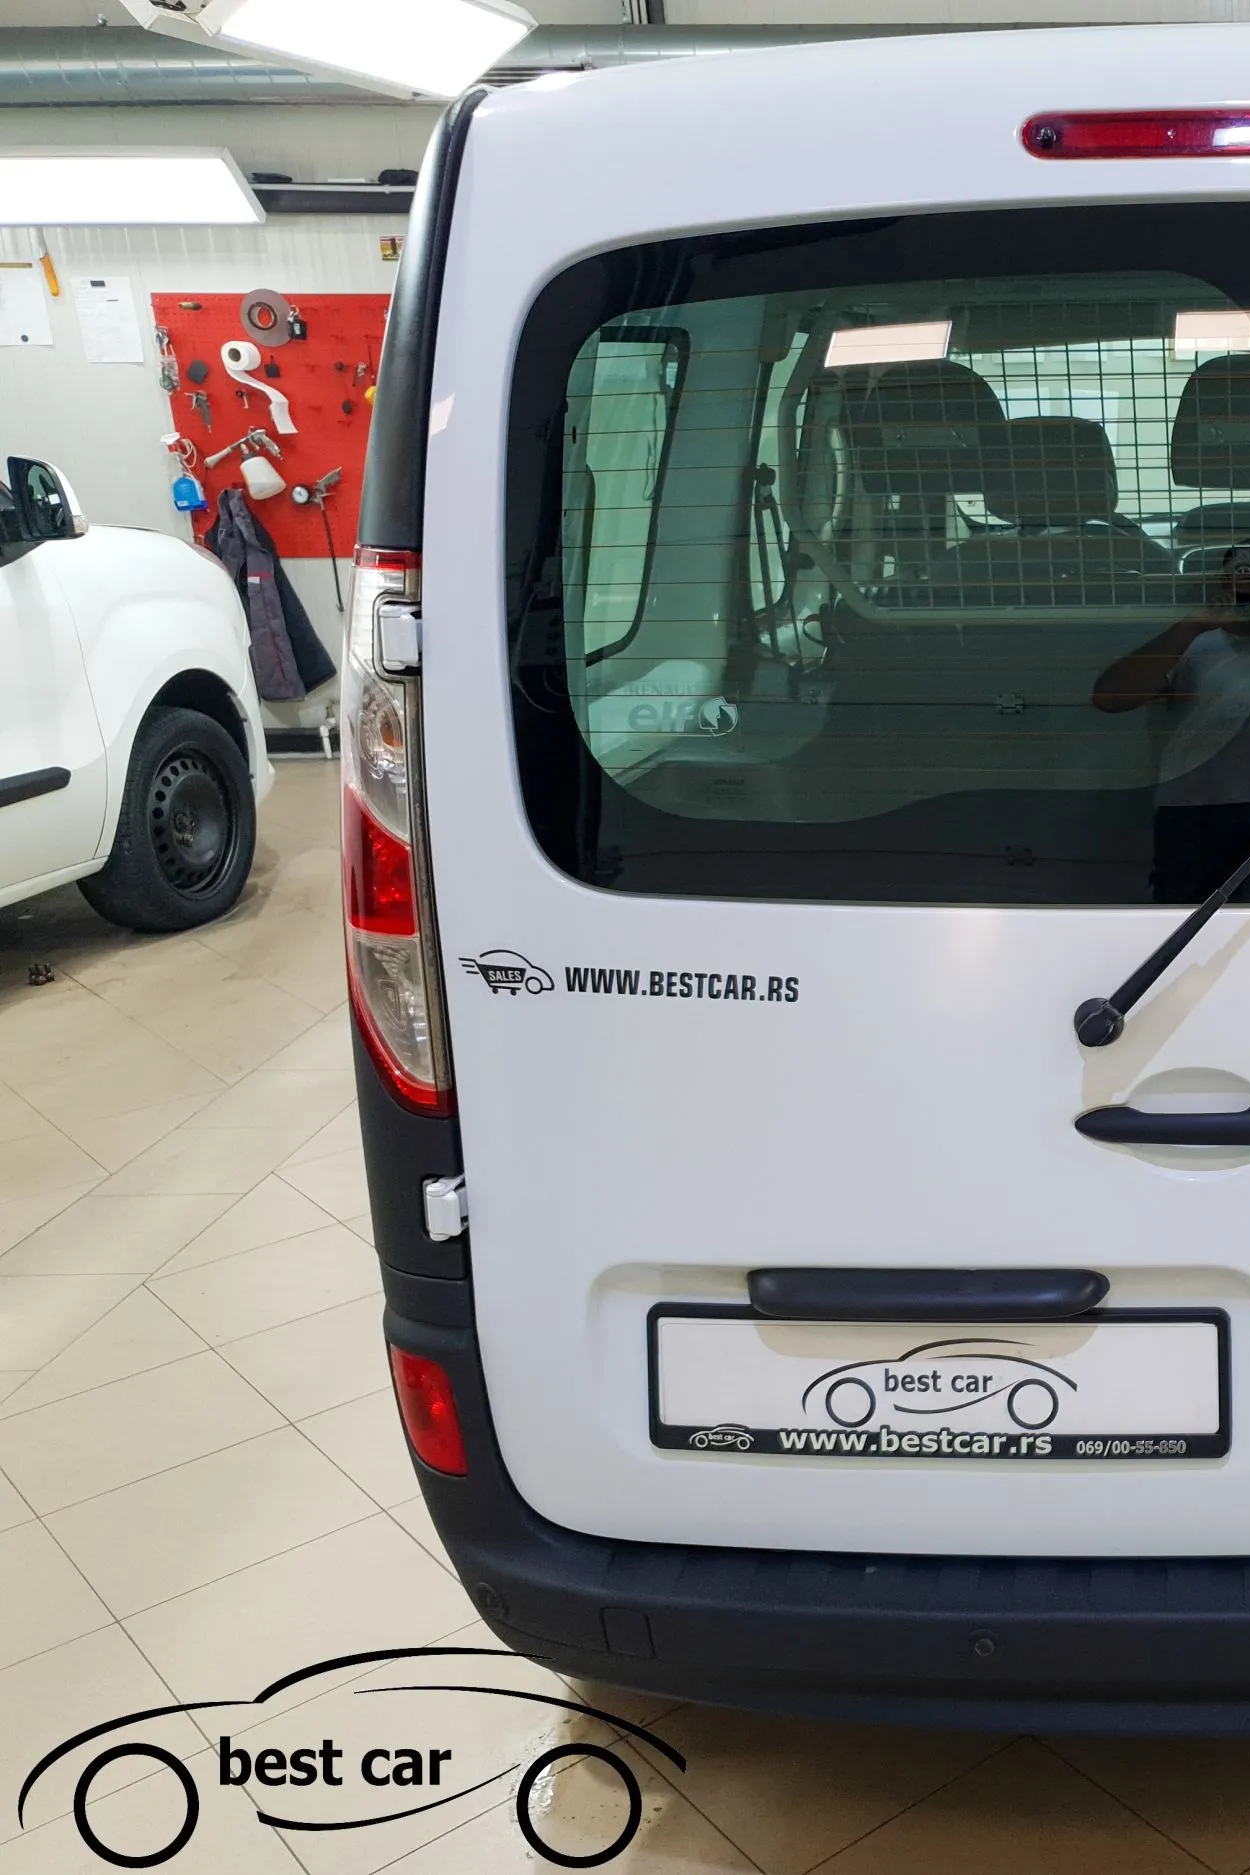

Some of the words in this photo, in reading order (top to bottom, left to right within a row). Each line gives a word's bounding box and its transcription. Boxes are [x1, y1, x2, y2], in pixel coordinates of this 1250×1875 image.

[628, 700, 695, 732] elf
[488, 969, 522, 983] SALES
[565, 966, 800, 1003] WWW.BESTCAR.RS
[884, 1367, 942, 1393] best
[950, 1373, 993, 1393] car
[778, 1428, 1053, 1454] www.bestcar.rs
[1076, 1440, 1187, 1457] 069/00-55-850
